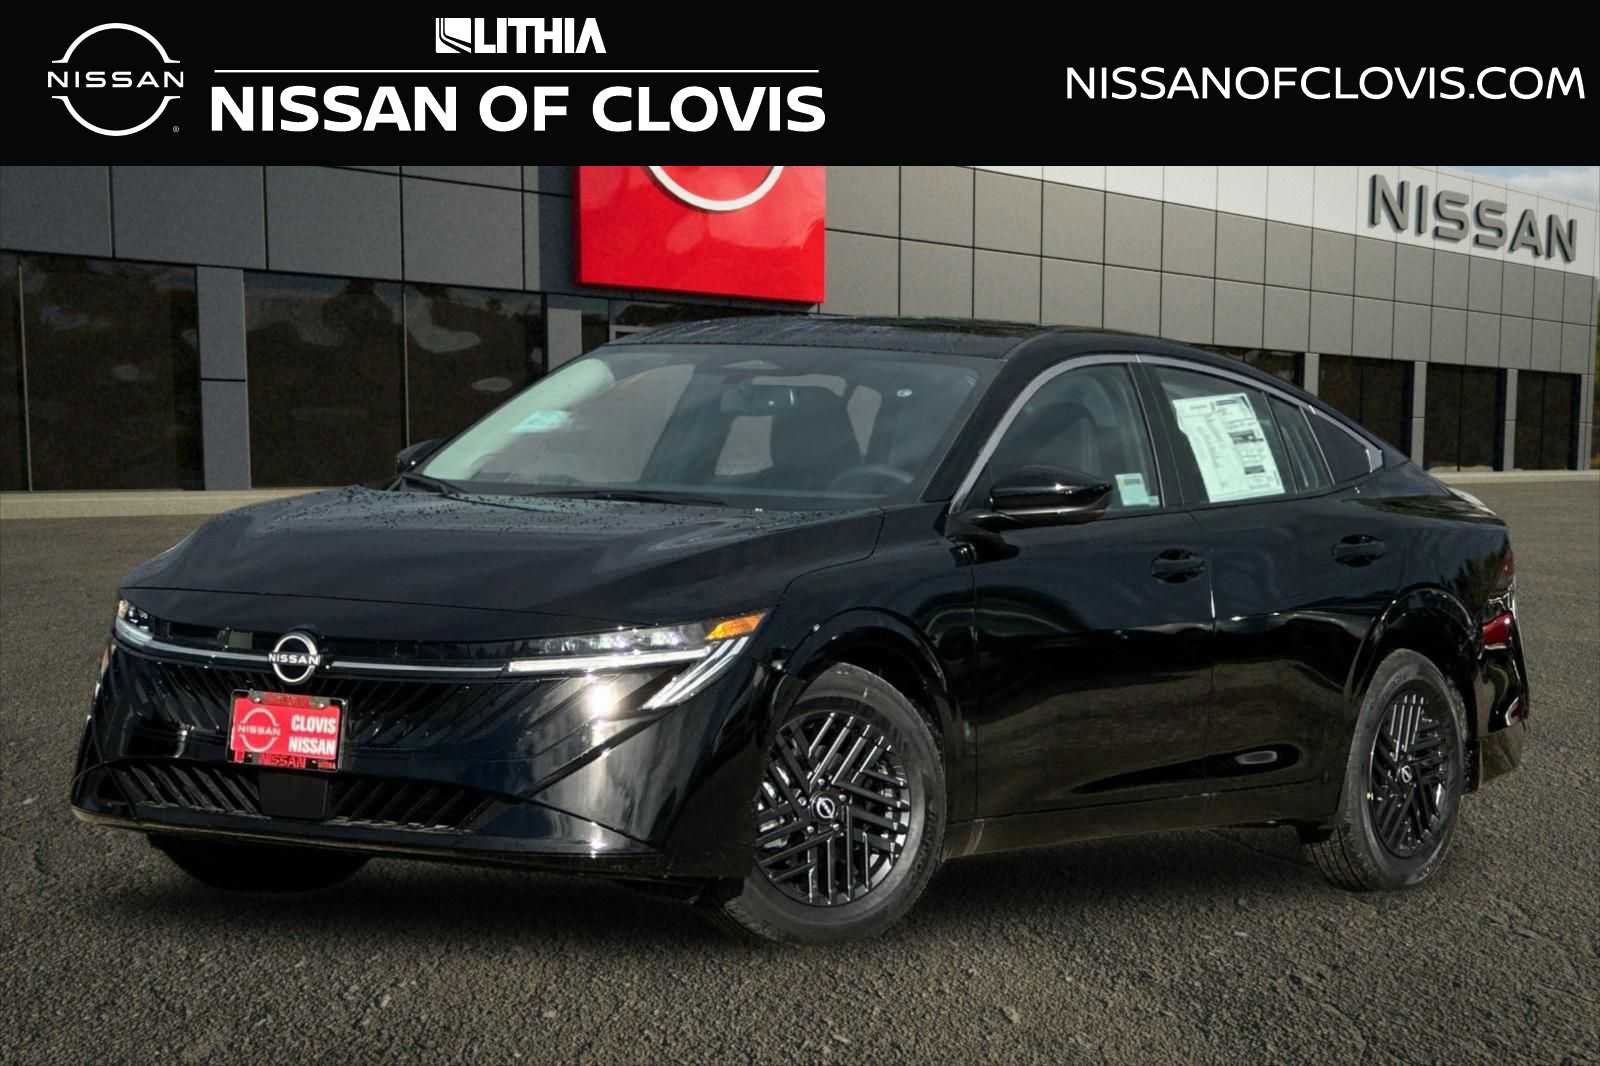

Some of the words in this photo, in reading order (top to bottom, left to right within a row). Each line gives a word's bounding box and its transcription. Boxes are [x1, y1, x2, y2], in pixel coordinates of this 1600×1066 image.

[1368, 174, 1577, 263] NISSAN
[268, 653, 320, 666] NISSAN
[237, 724, 281, 737] NISSAN
[291, 714, 337, 735] CLOVIS
[287, 736, 337, 755] NISSAN
